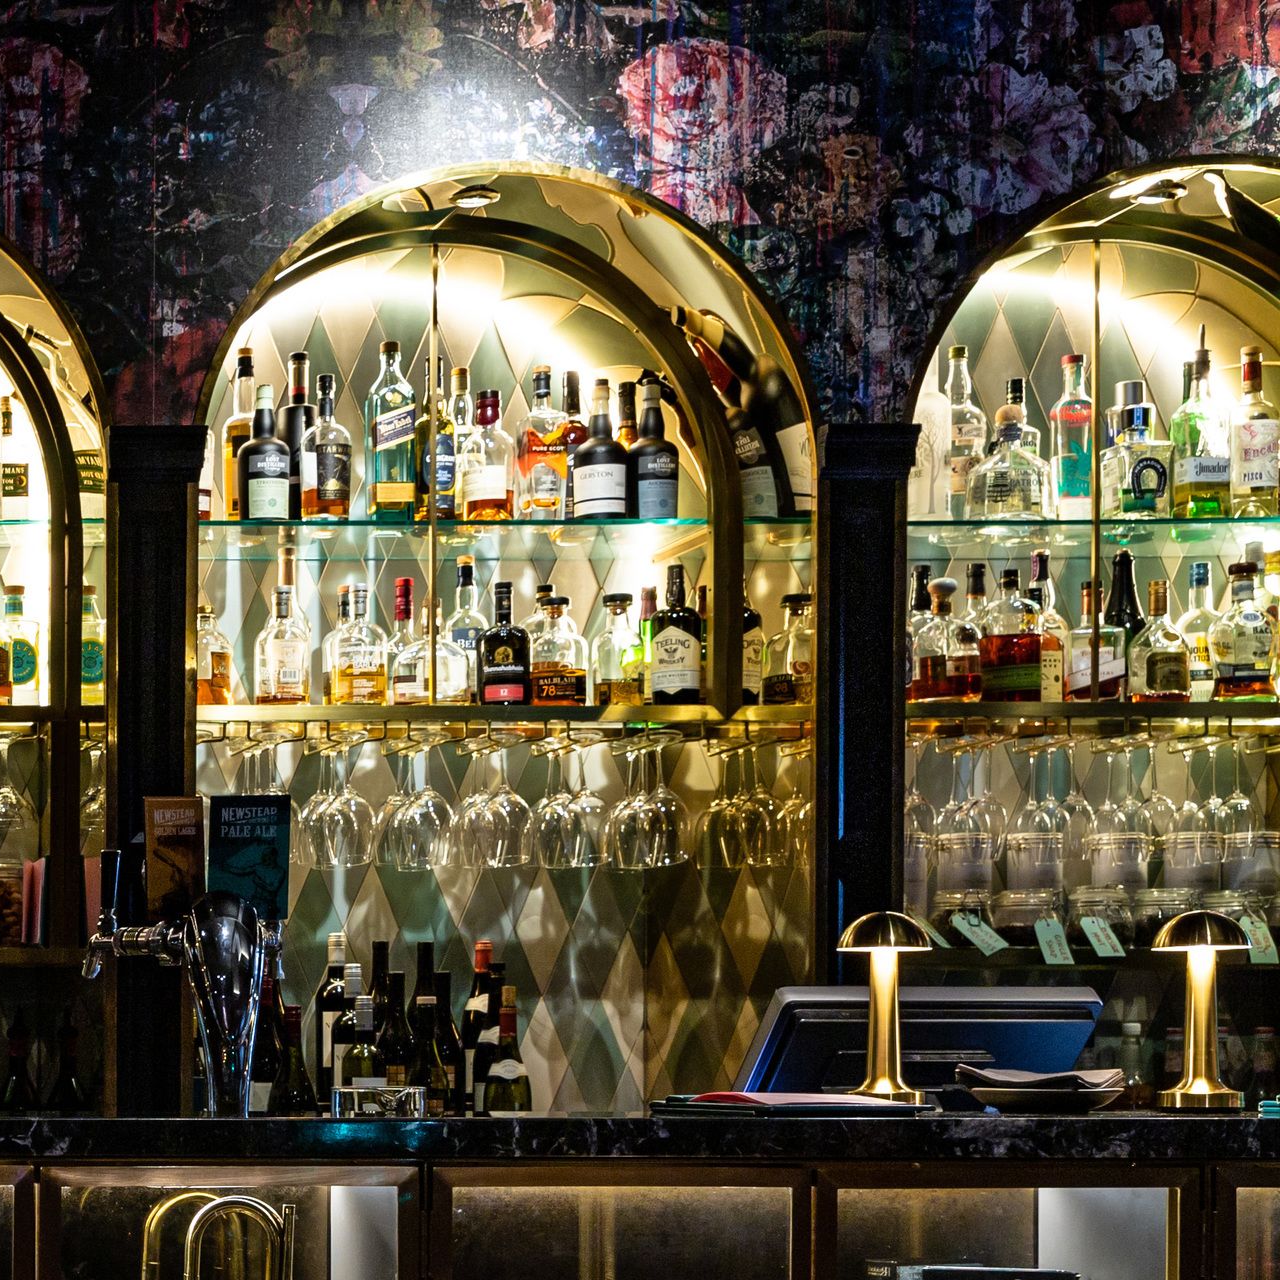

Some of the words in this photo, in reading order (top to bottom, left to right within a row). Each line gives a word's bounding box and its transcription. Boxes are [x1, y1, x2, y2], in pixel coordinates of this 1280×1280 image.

[1197, 461, 1229, 475] Jimador
[1242, 471, 1263, 482] PISCO
[655, 639, 690, 650] TEELING
[658, 656, 685, 665] WHISKEY
[154, 808, 195, 825] NEWSTEAD
[221, 806, 278, 823] NEWSTEAD
[221, 825, 250, 838] PALE
[253, 825, 277, 838] ALE
